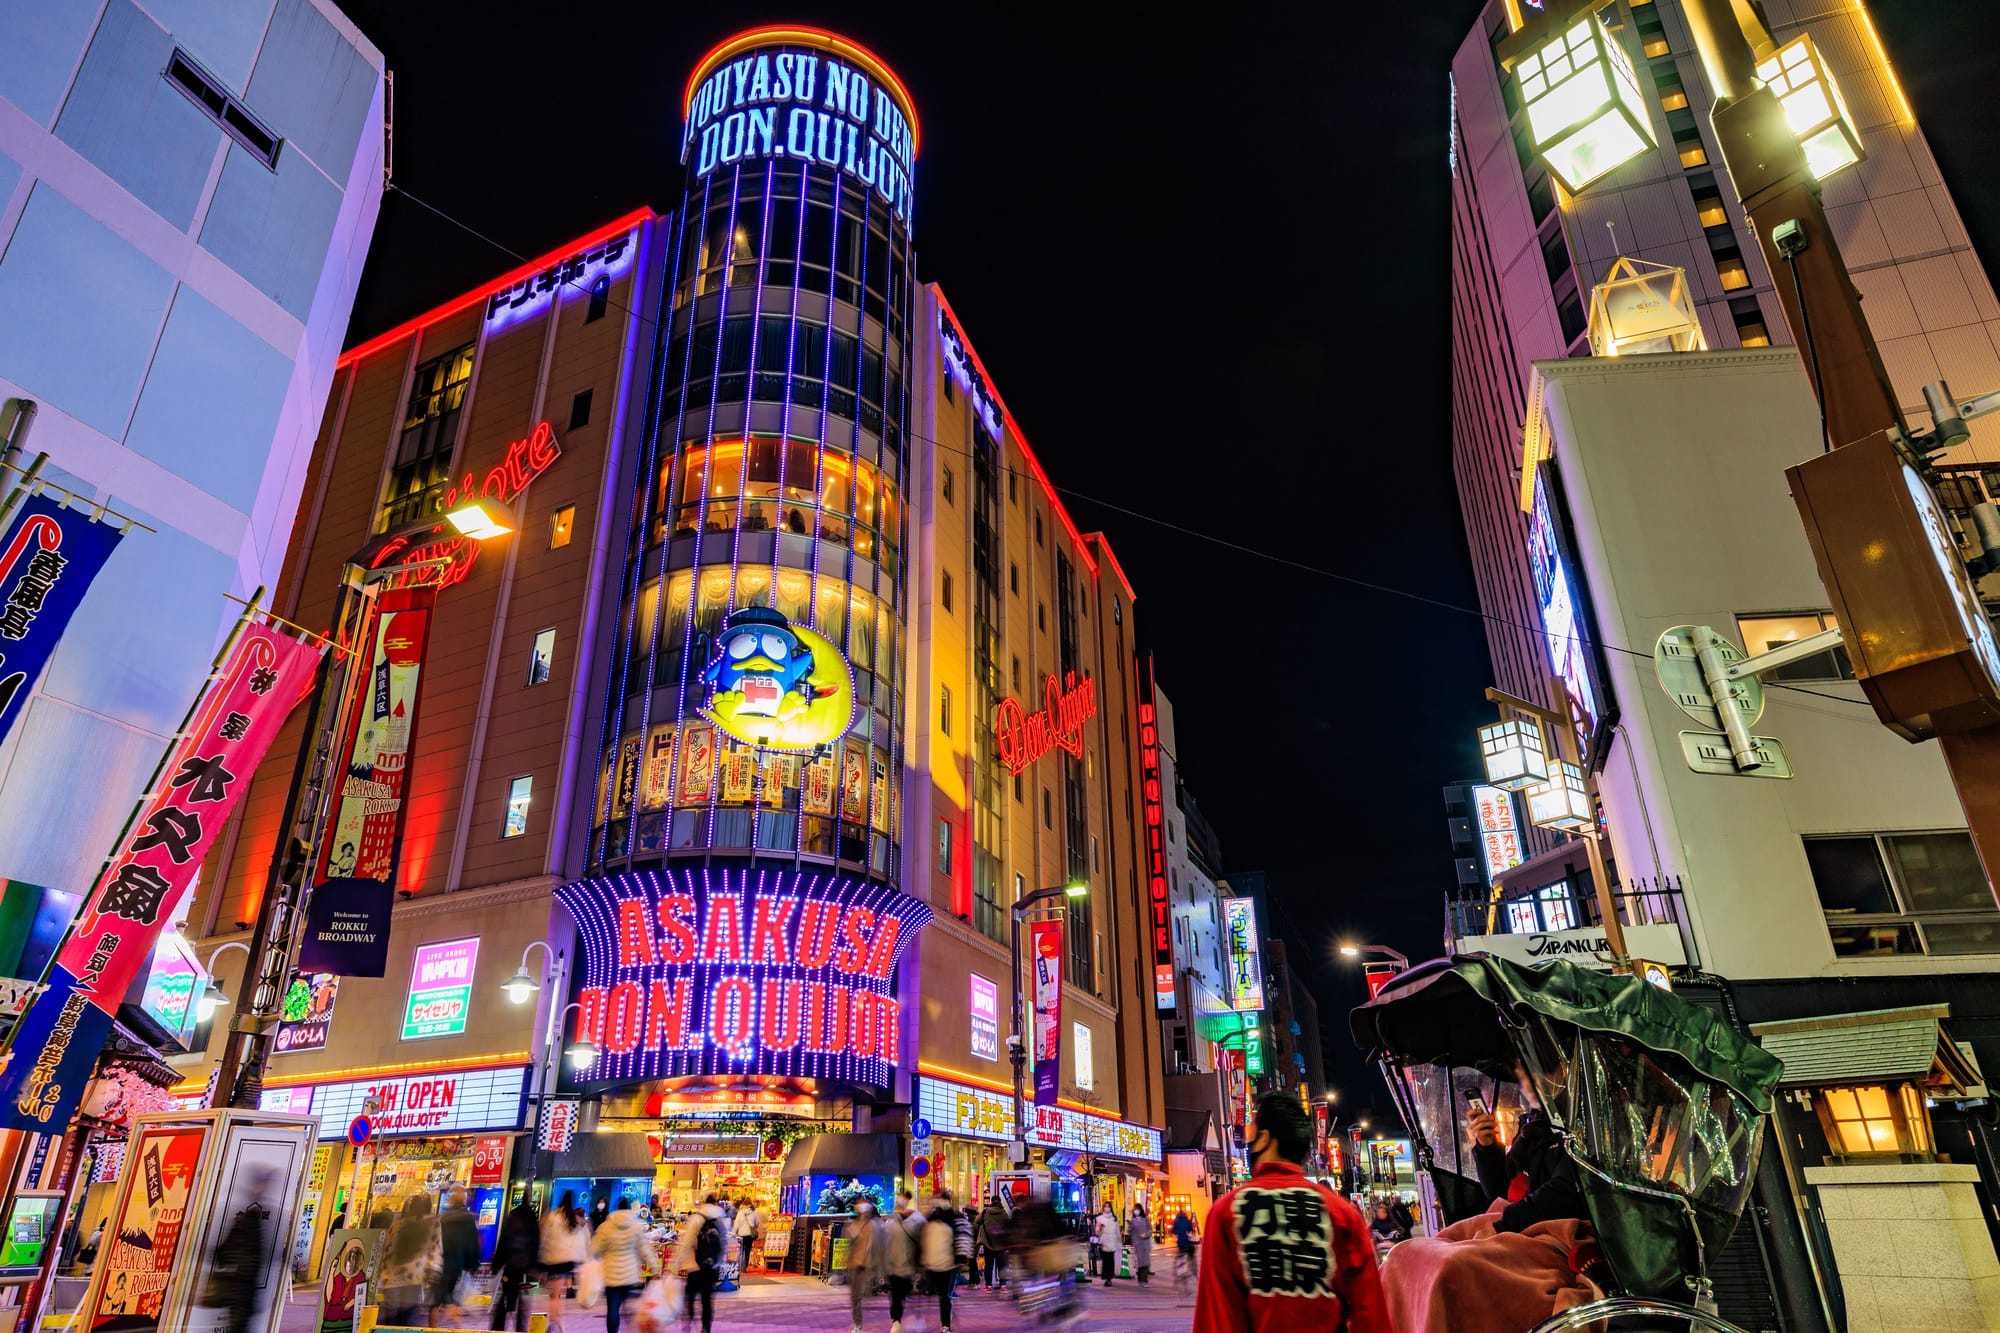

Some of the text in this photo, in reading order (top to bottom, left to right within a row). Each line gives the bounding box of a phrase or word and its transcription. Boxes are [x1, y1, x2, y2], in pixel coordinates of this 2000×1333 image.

[681, 53, 818, 165] YOUYASU
[823, 60, 869, 125] NO
[376, 668, 389, 714] 浅草六区
[341, 774, 393, 800] ASAKUSA
[361, 796, 401, 816] ROKKU
[1140, 704, 1169, 950] DON.QUIJOTE
[1497, 804, 1518, 859] カラオケ
[331, 921, 369, 933] ROKKU
[334, 910, 370, 920] Welcome to
[317, 931, 377, 944] BROADWAY
[617, 893, 901, 980] ASAKUSA
[1525, 935, 1612, 957] JAPANKUR
[407, 1079, 456, 1110] OPEN
[146, 1155, 160, 1200] 浅草六区
[108, 1239, 157, 1272] ASAKUSA
[129, 1273, 170, 1297] ROKKU
